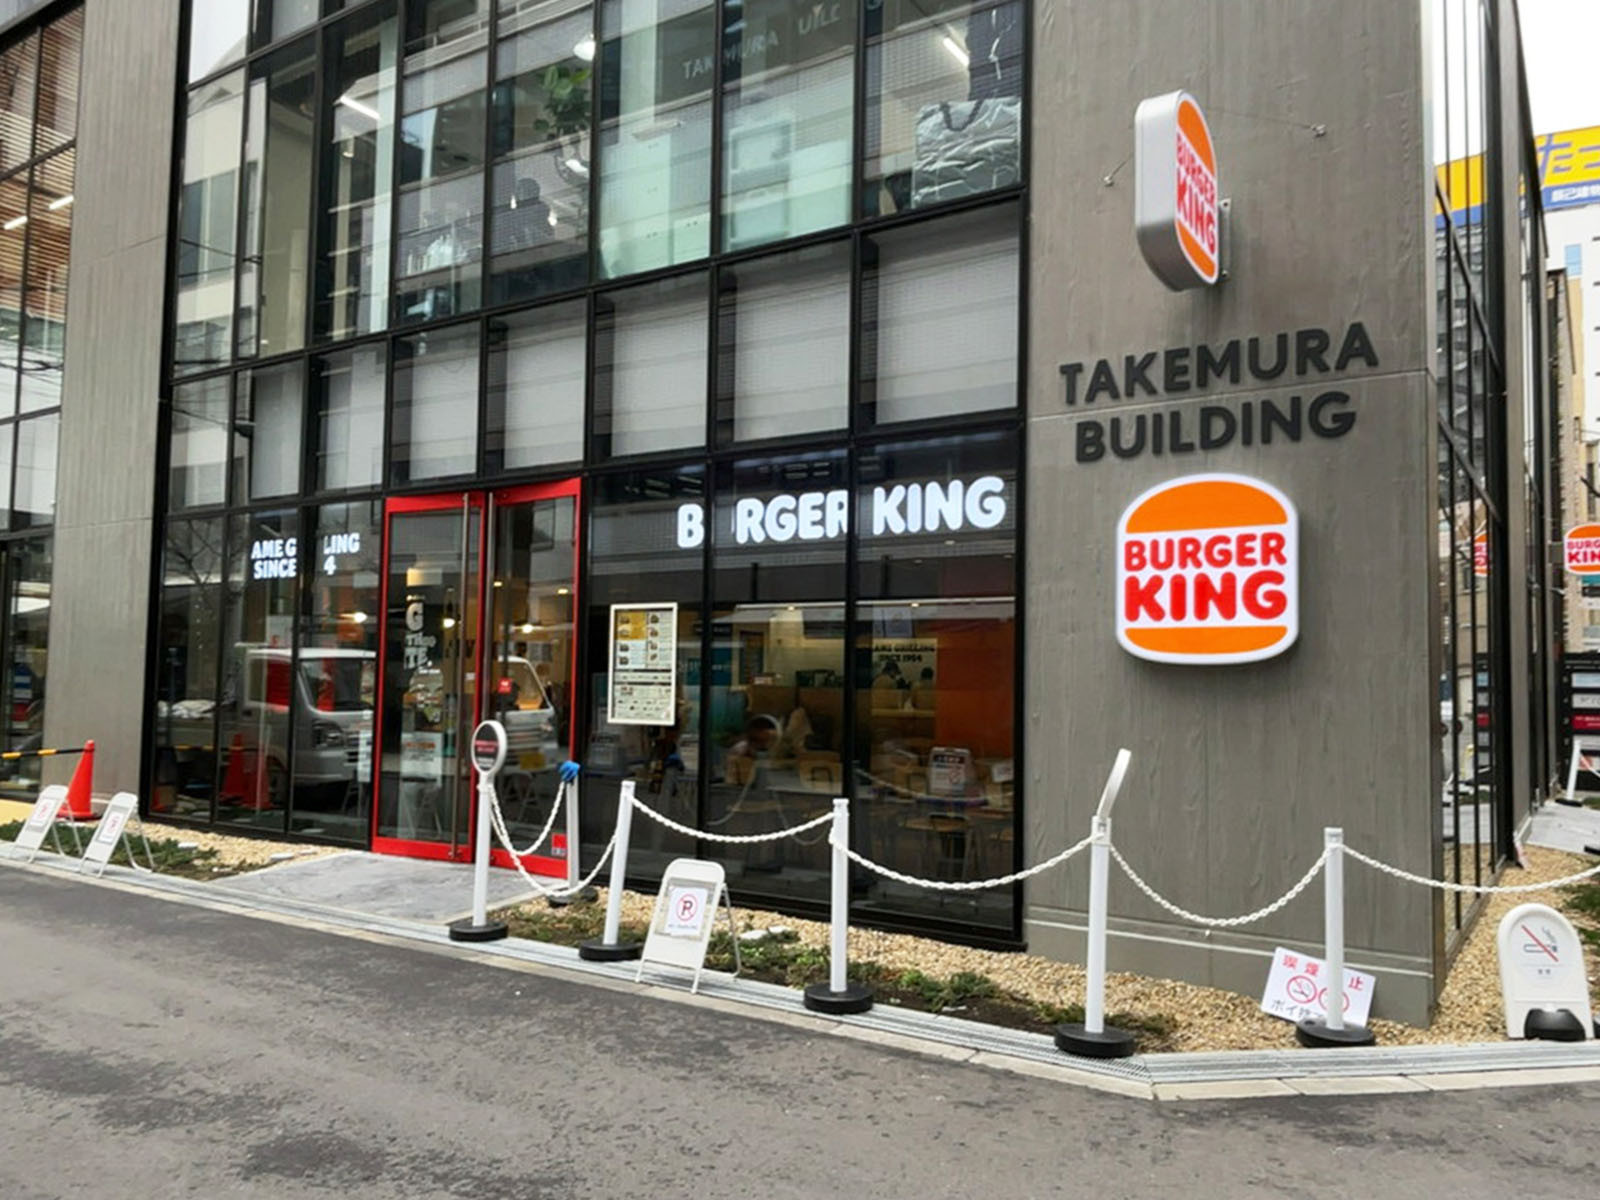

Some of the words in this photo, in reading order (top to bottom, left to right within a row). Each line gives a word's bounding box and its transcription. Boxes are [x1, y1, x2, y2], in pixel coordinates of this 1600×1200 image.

[1177, 166, 1216, 255] KING
[1059, 322, 1379, 405] TAKEMURA
[1075, 391, 1357, 464] BUILDING
[677, 489, 848, 548] BRGER
[873, 476, 1006, 536] KING
[251, 539, 284, 559] AME
[1125, 532, 1287, 572] BURGER
[1567, 540, 1600, 550] BURG
[1567, 550, 1600, 563] KIN
[254, 558, 297, 579] SINCE
[1125, 570, 1288, 622] KING
[1282, 954, 1364, 992] 喫煙止
